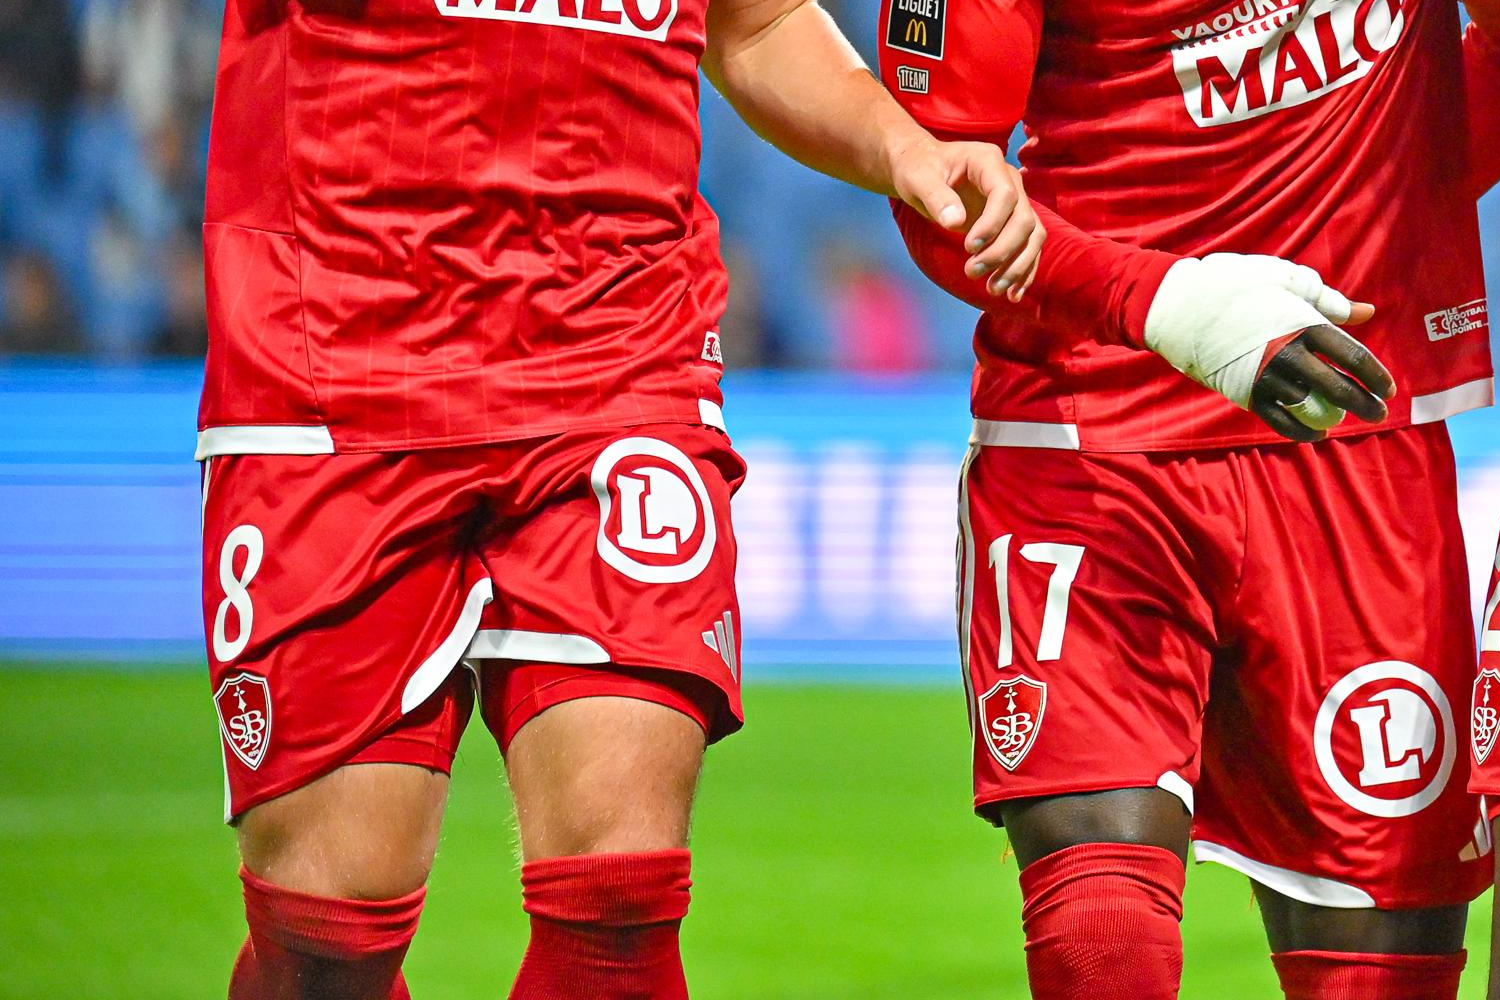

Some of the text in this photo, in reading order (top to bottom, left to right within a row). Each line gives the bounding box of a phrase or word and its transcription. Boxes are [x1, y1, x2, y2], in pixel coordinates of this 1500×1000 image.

[213, 524, 264, 663] 8
[988, 533, 1085, 670] 17
[229, 710, 265, 740] SB
[991, 712, 1033, 739] SB
